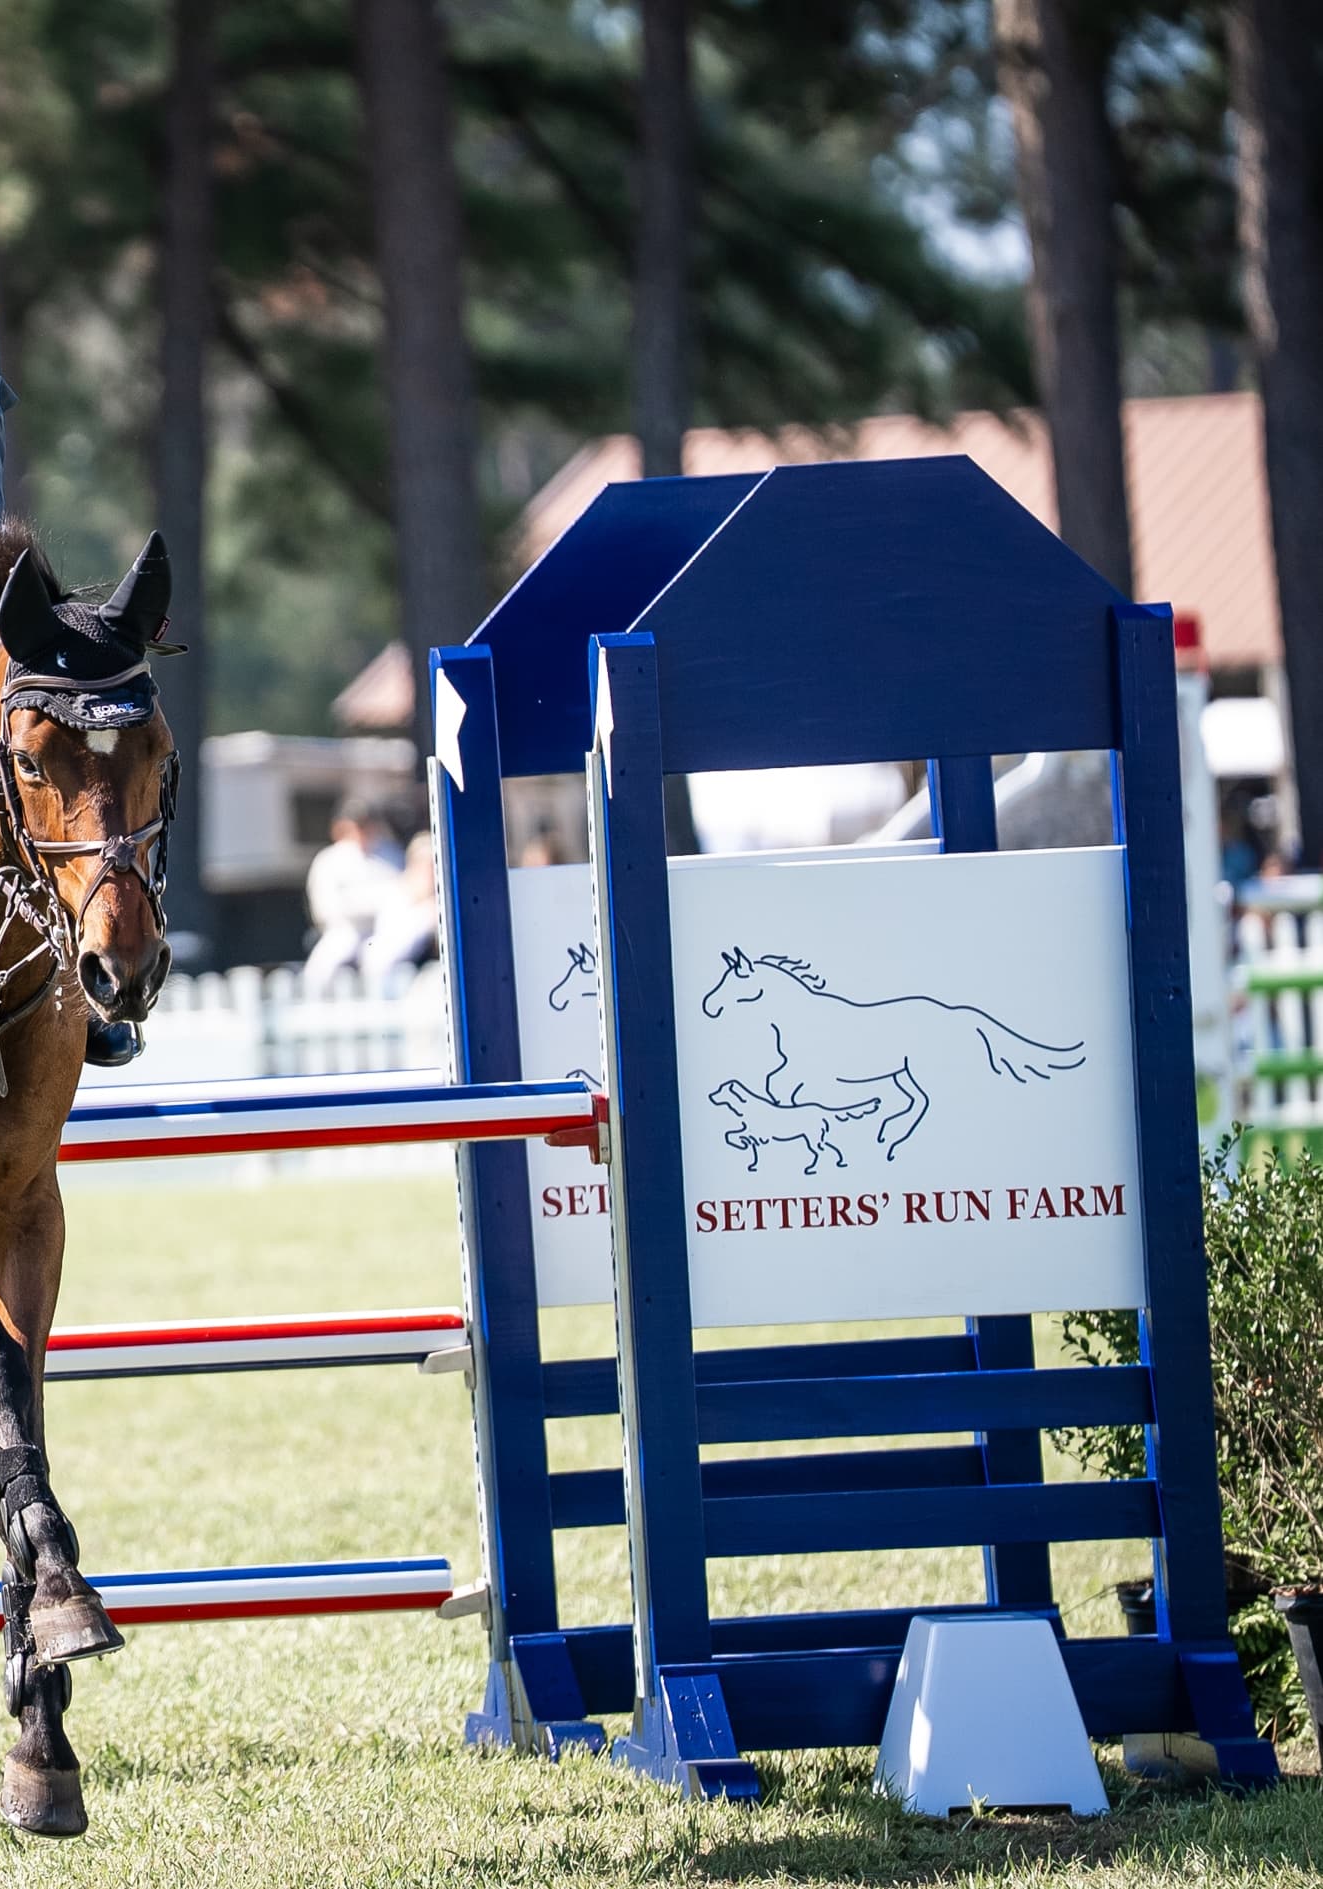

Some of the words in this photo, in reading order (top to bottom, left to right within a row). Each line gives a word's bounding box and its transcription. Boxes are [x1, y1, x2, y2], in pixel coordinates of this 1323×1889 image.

[695, 1191, 890, 1233] SETTERS’
[902, 1189, 993, 1224] RUN
[1005, 1183, 1127, 1220] FARM
